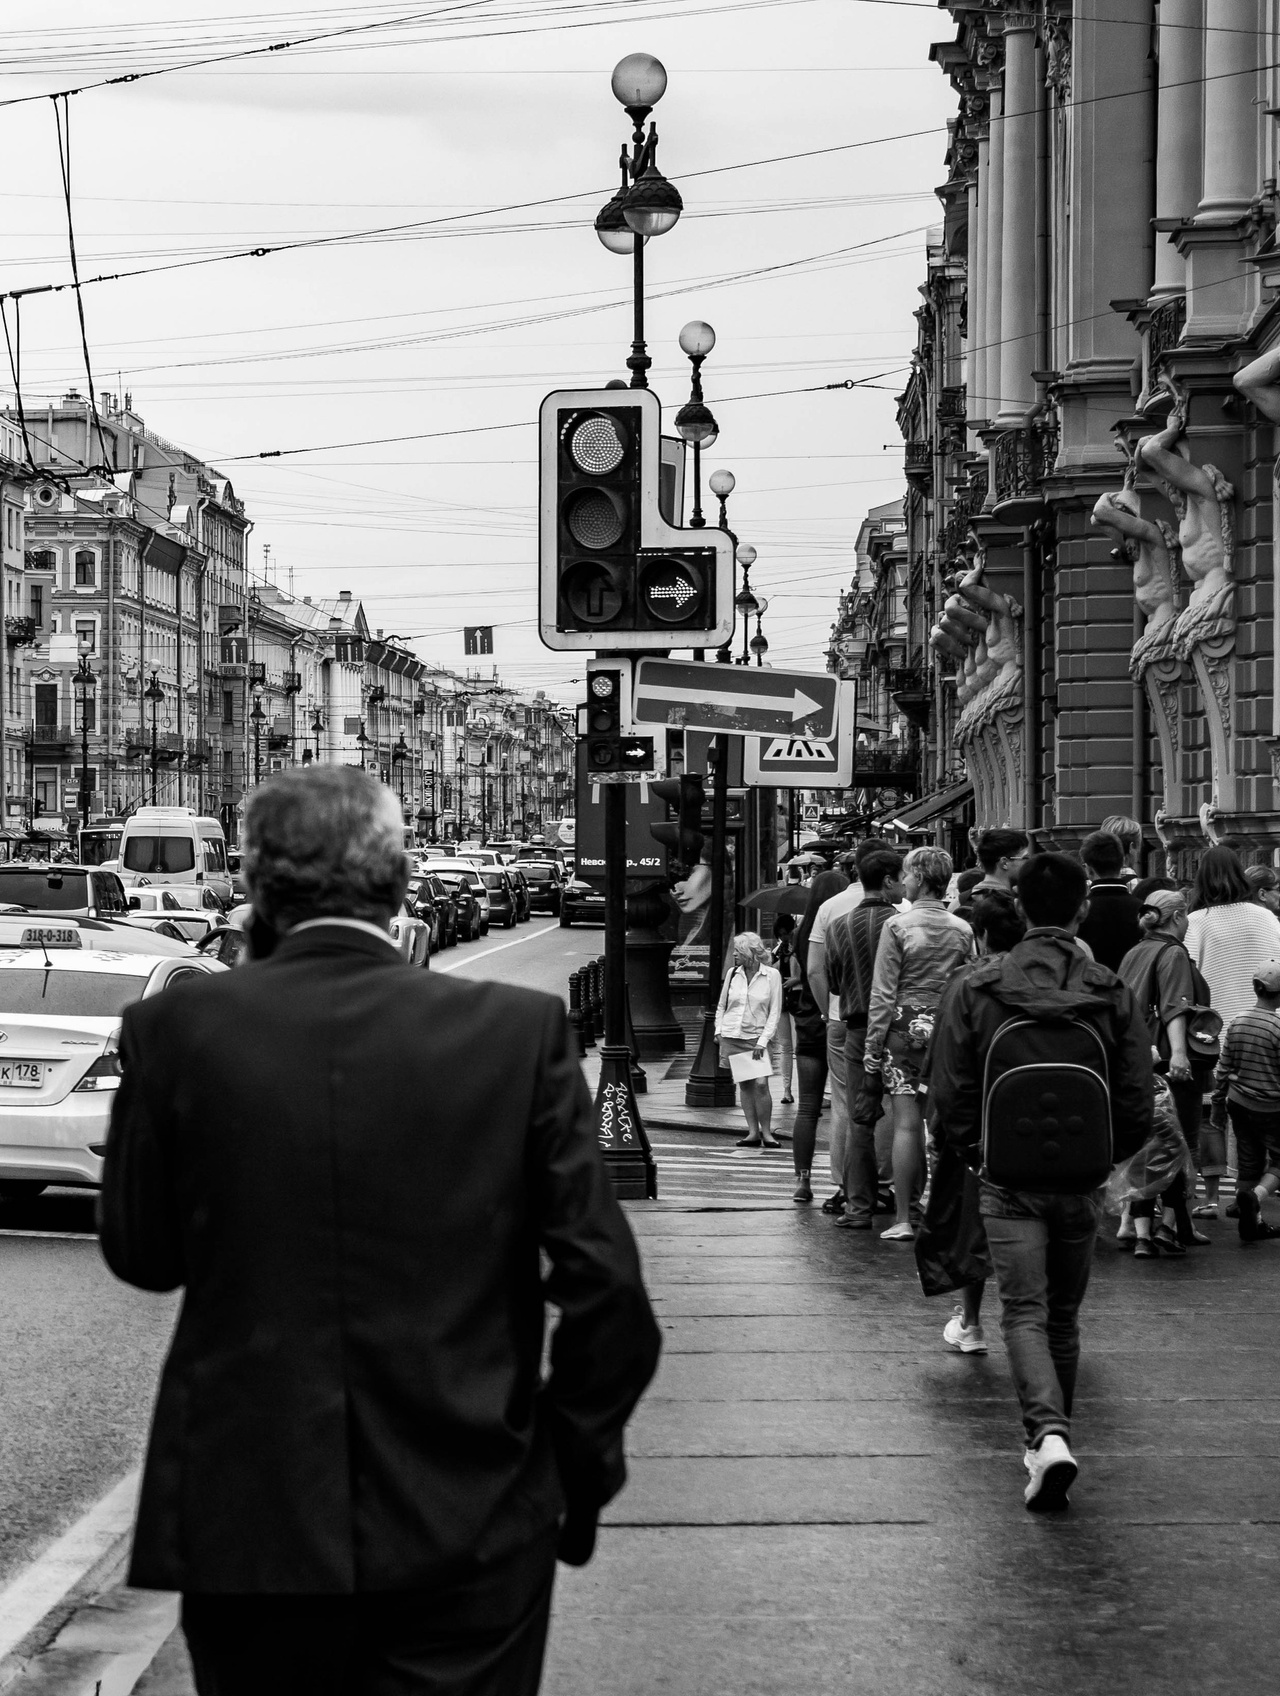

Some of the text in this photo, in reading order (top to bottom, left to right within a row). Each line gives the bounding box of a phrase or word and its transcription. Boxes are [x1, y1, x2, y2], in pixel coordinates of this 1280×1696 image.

[639, 857, 661, 867] 45/2
[26, 928, 73, 943] 318-0-318
[15, 1063, 38, 1077] 178
